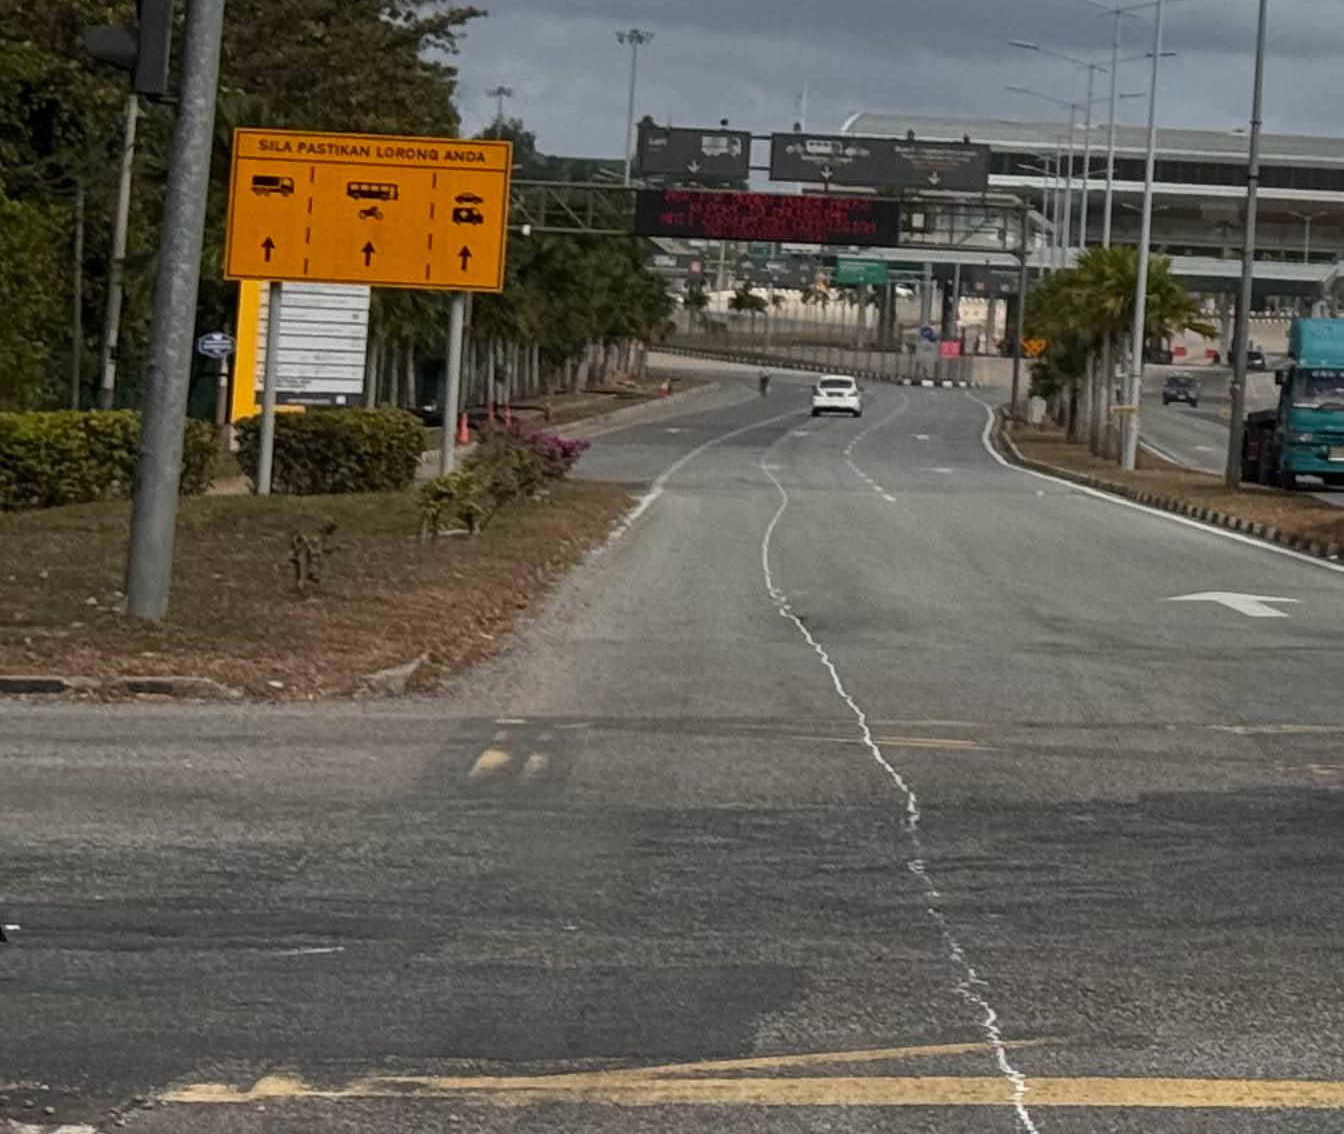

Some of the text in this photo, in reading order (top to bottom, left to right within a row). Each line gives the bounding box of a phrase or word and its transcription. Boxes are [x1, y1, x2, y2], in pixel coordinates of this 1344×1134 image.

[258, 139, 486, 163] SILA PASTIKAN LORONG ANDA
